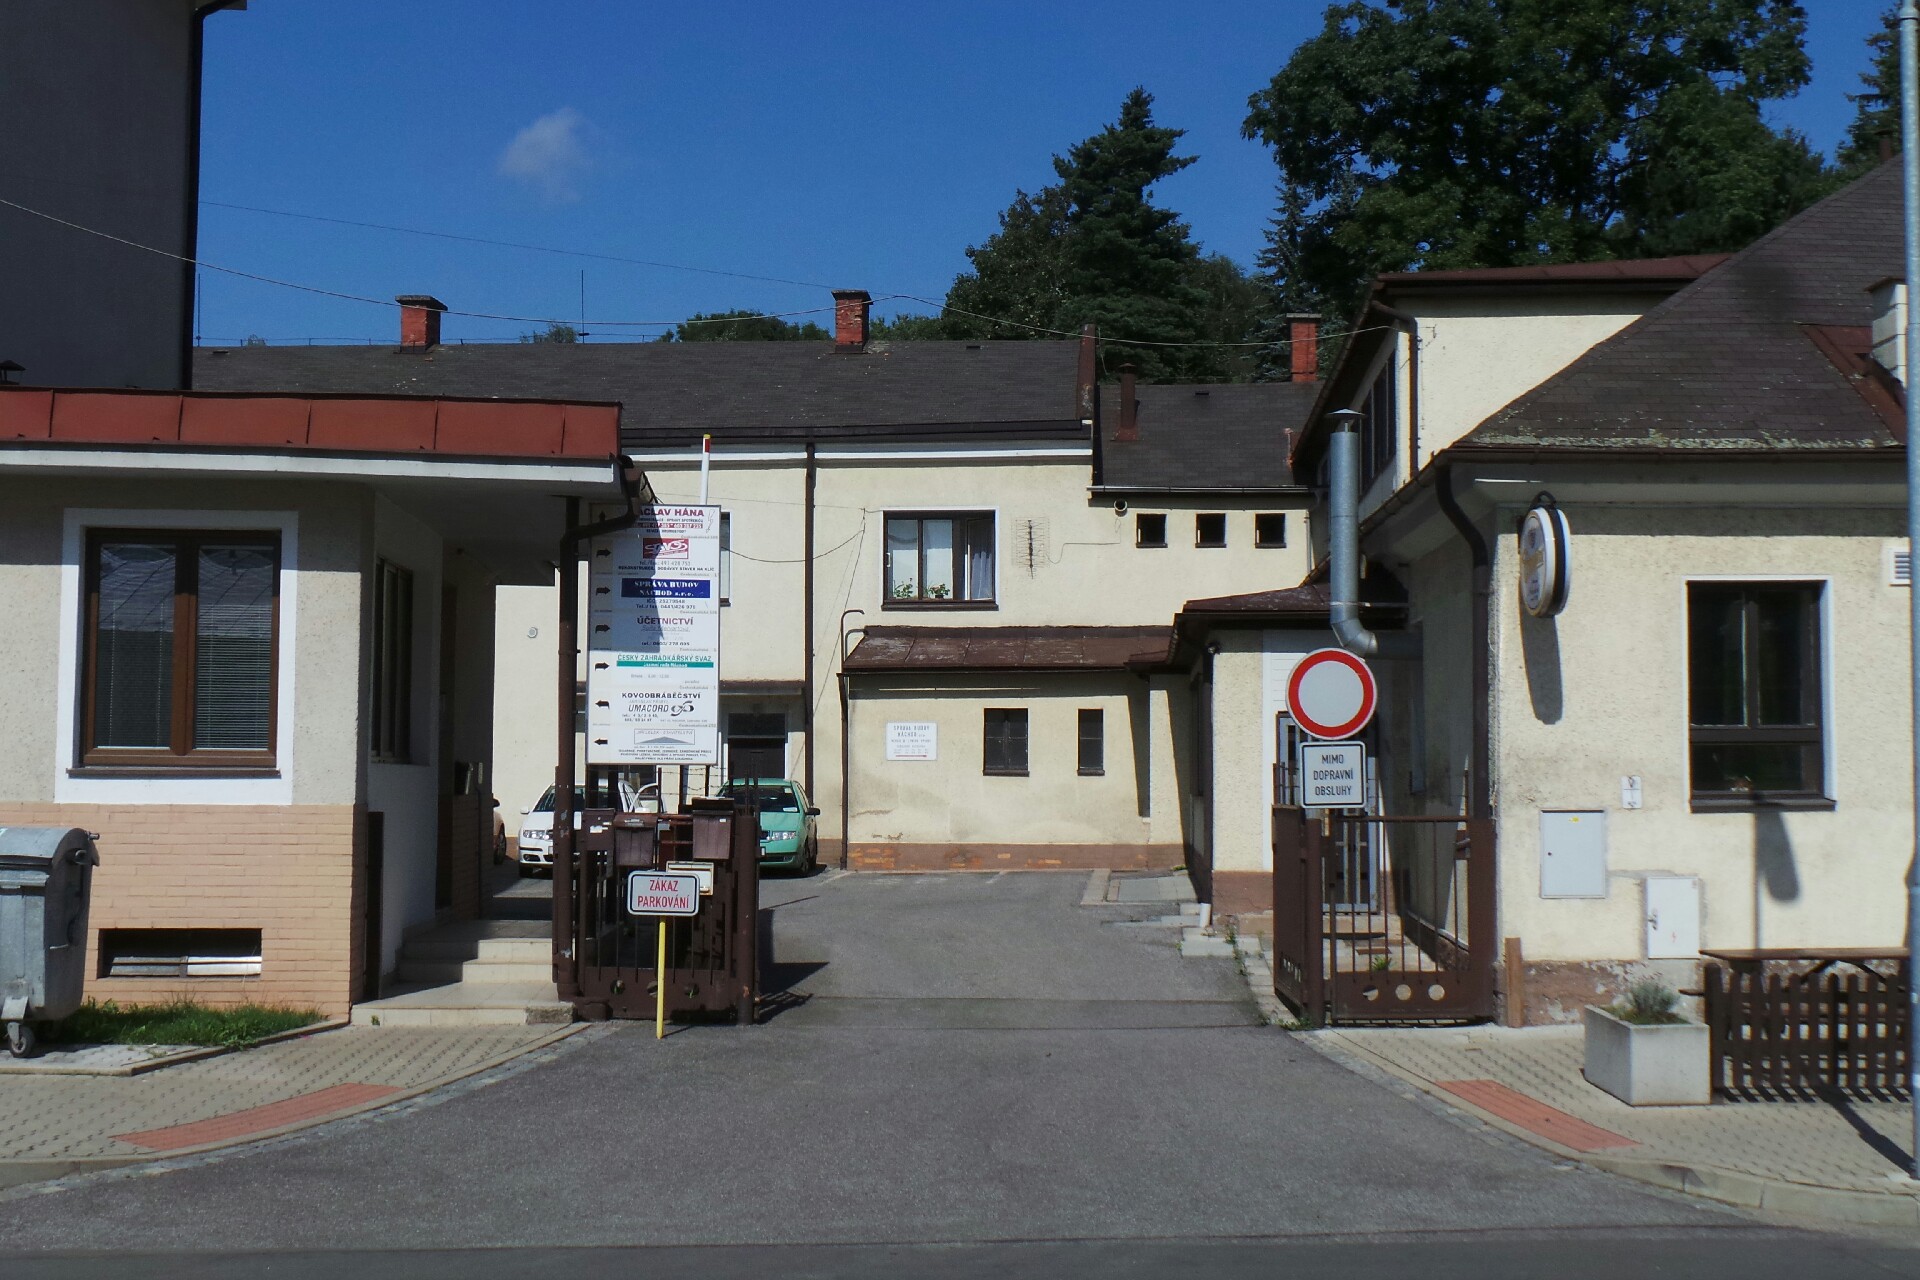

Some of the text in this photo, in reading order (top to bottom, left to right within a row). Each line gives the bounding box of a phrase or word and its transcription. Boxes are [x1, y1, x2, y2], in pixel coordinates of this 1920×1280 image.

[639, 508, 704, 516] CLAV HÁNA
[634, 580, 668, 588] SPRÁVA
[637, 616, 694, 625] ÚČETNICTVÍ
[1322, 754, 1344, 764] MIMO
[1314, 768, 1354, 780] DOPRAVNÍ
[1315, 786, 1352, 796] OBSLUHY
[650, 878, 678, 891] ZÁKAZ
[638, 894, 689, 908] PARKOVÁNÍ
